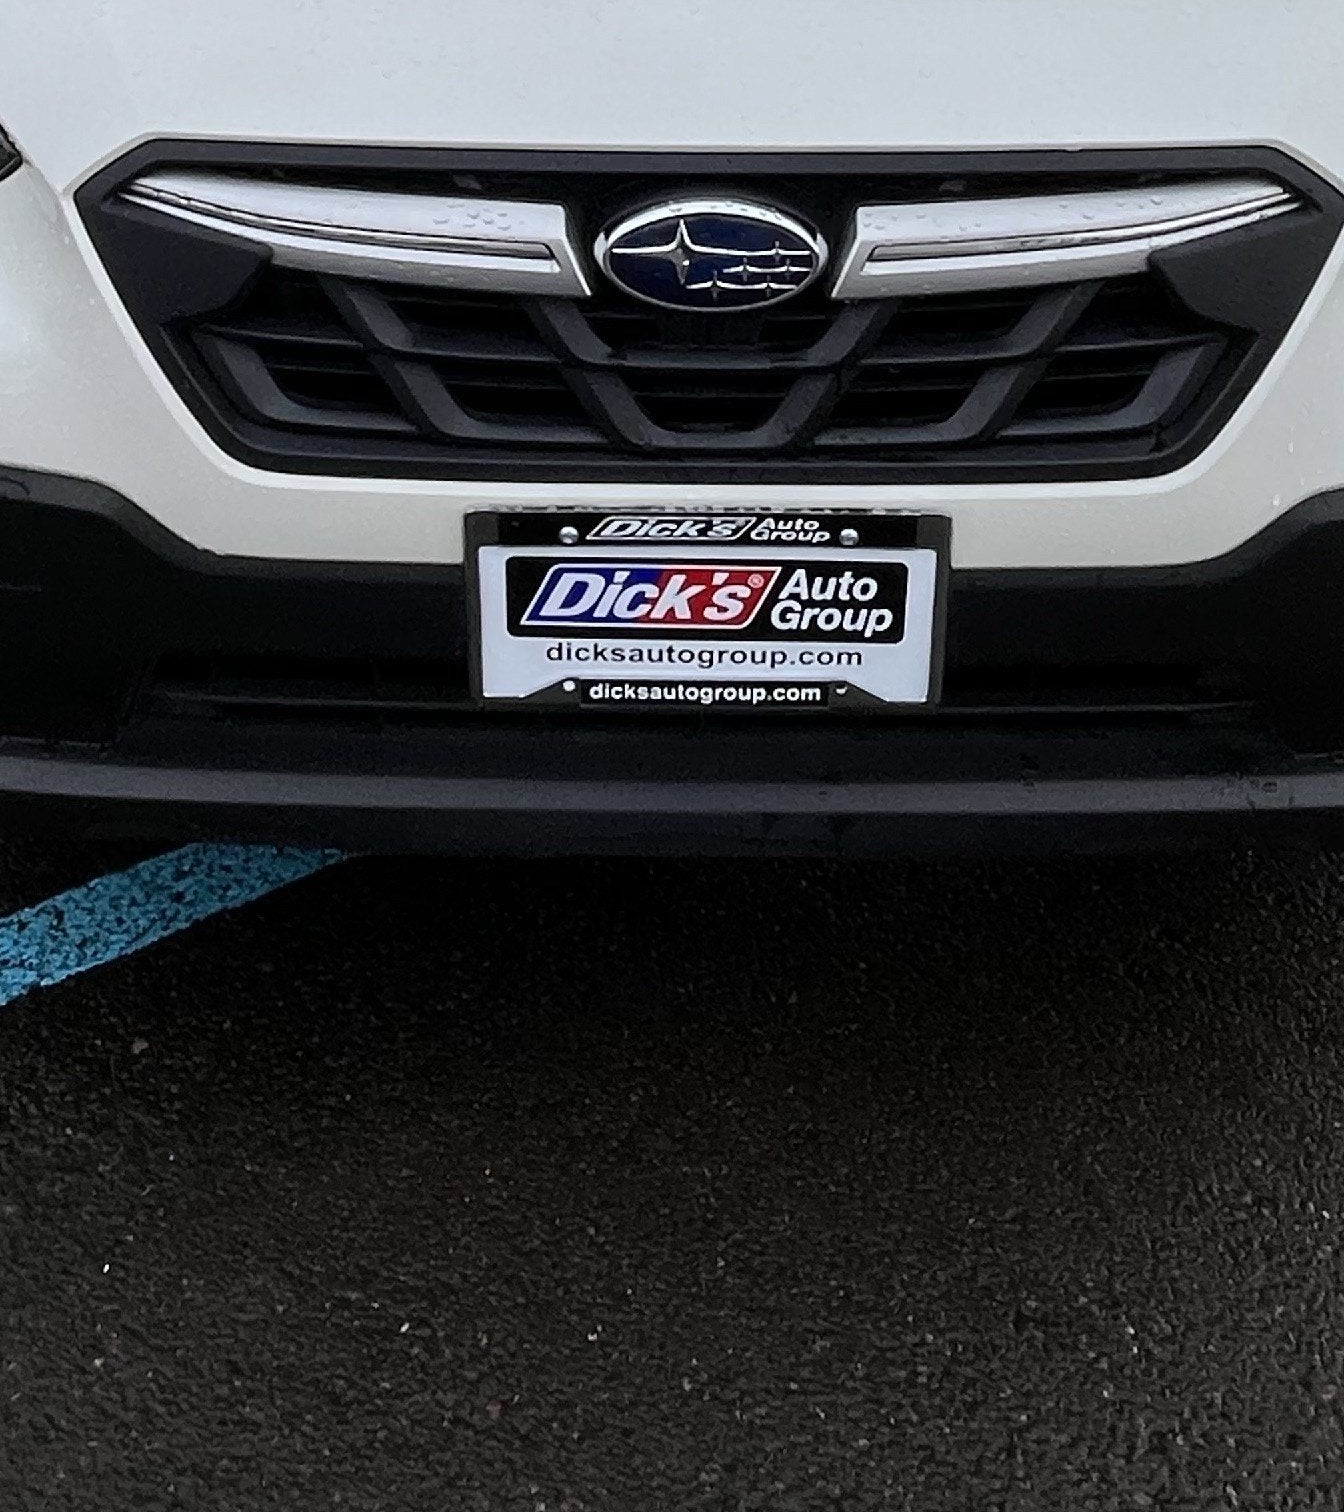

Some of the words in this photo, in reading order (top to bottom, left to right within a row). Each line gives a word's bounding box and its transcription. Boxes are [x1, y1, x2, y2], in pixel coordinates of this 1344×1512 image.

[750, 528, 831, 543] Group
[758, 517, 820, 531] Auto
[539, 570, 752, 620] Dick's
[779, 569, 878, 601] Auto
[770, 600, 894, 638] Group
[546, 642, 863, 669] dicksautogroup.com
[589, 682, 822, 704] dicksautogroup.com
